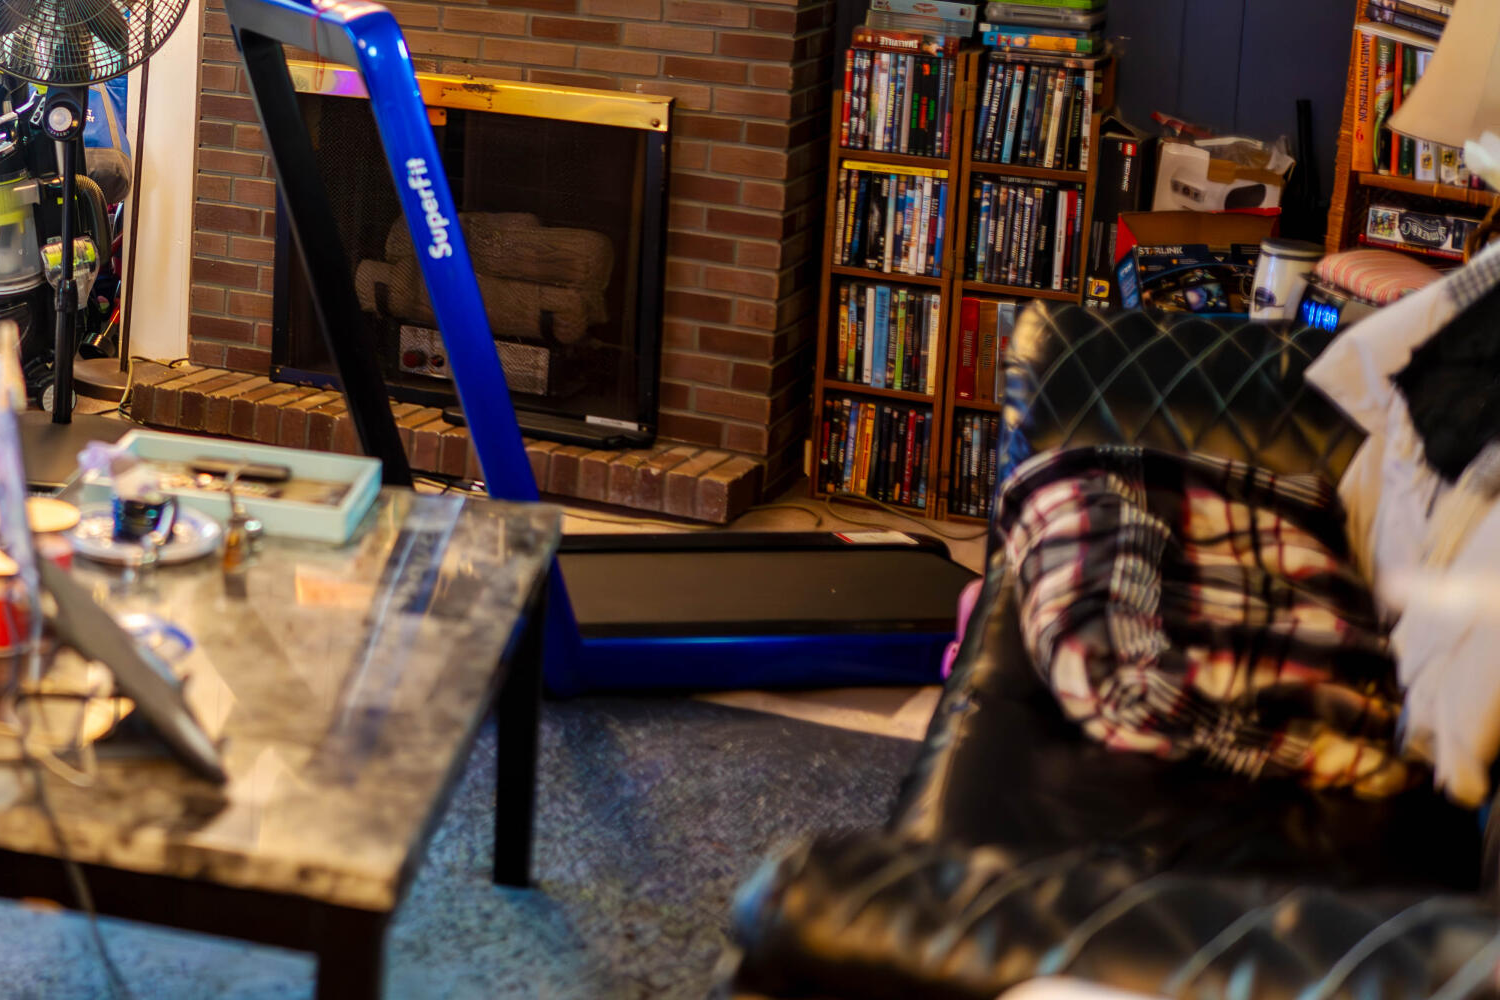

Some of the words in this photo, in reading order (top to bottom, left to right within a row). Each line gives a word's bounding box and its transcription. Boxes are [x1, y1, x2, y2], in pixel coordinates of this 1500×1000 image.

[1359, 32, 1373, 65] JAMES
[1377, 43, 1389, 76] playing
[1357, 65, 1371, 123] PATTERSON
[405, 157, 453, 260] SuperFit
[1138, 245, 1183, 255] STARLINK
